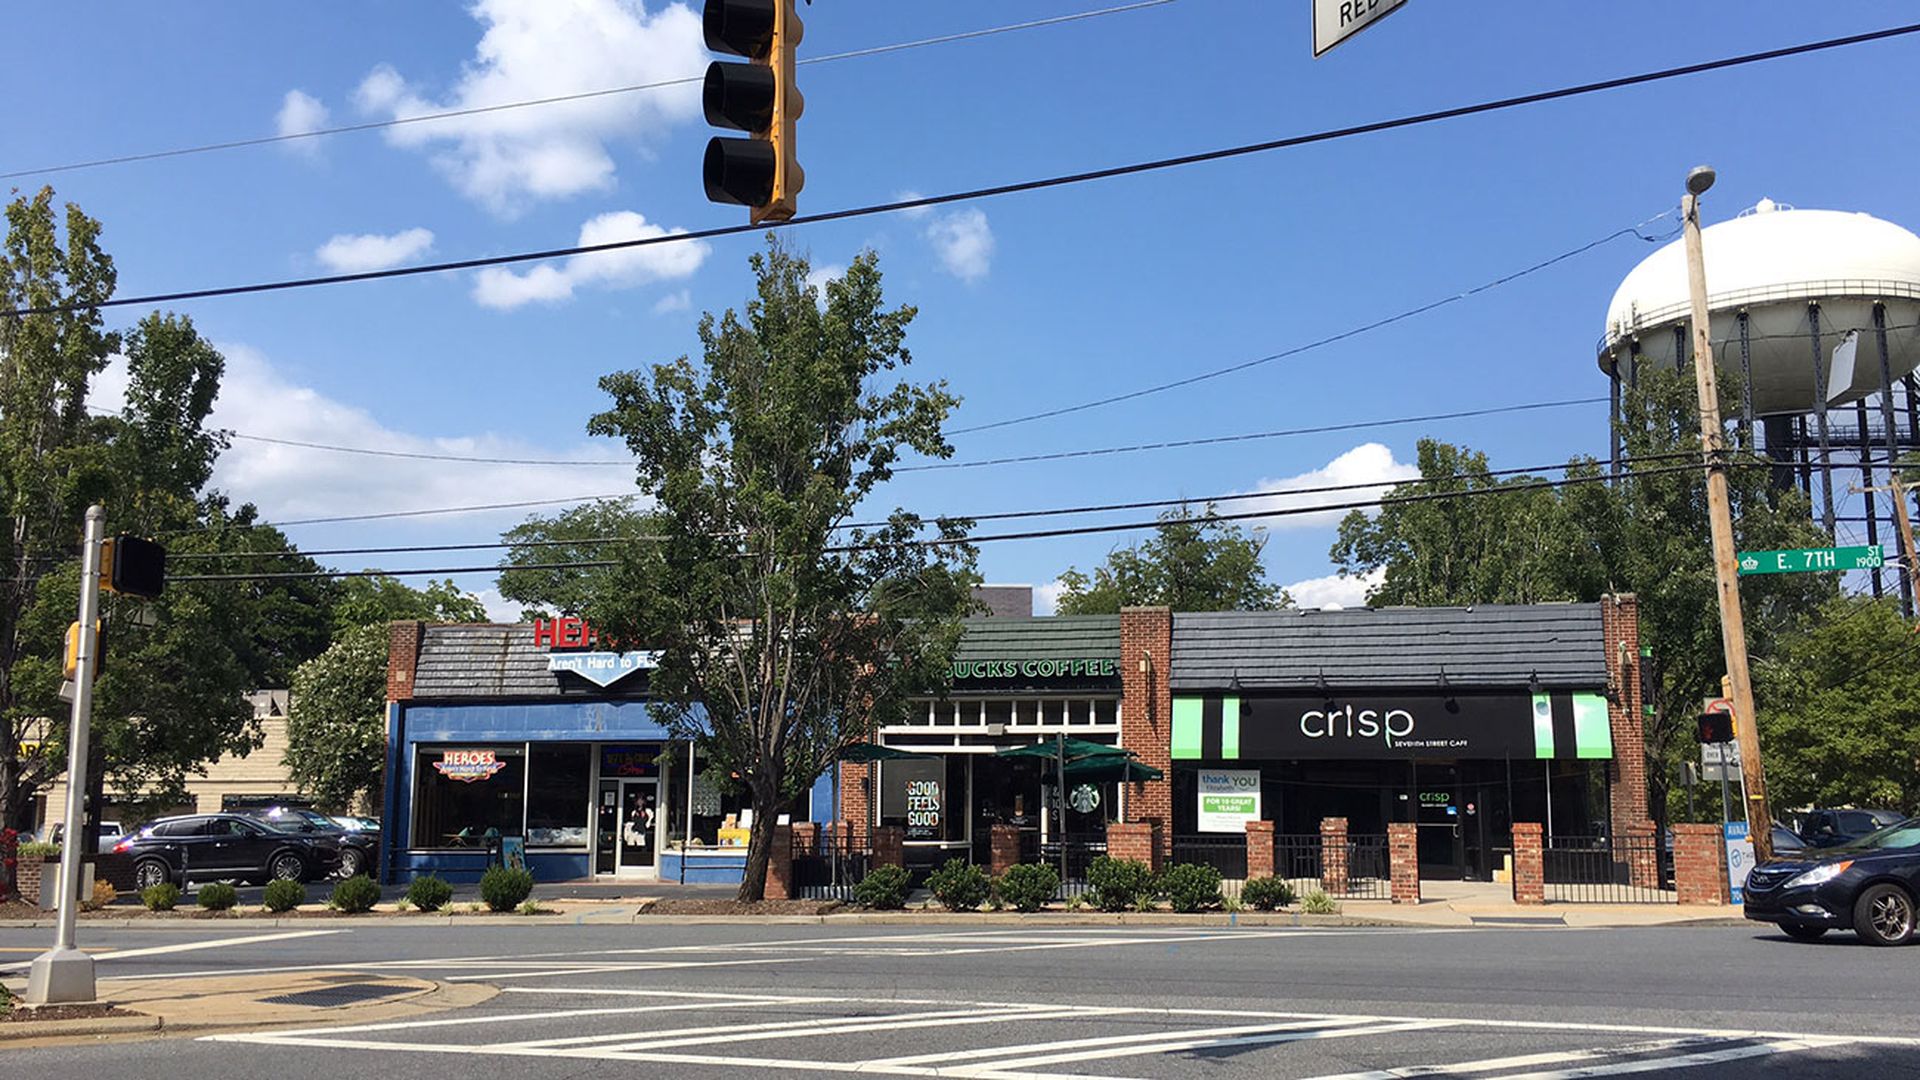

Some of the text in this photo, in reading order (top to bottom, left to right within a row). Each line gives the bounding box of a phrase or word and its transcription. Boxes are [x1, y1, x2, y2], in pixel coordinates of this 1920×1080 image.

[1867, 545, 1880, 557] ST
[1777, 551, 1836, 569] E. 7TH
[1856, 557, 1881, 568] 1900
[548, 657, 582, 670] Aren't
[587, 656, 614, 669] Hard
[620, 657, 632, 669] to
[1022, 658, 1114, 678] COFFEE
[1300, 704, 1414, 749] crisp
[444, 751, 494, 765] HEROES
[1202, 774, 1256, 787] thank YOU
[906, 781, 939, 796] GOOD
[907, 796, 940, 811] FEELS
[1419, 792, 1450, 803] crisp
[907, 811, 939, 827] GOOD
